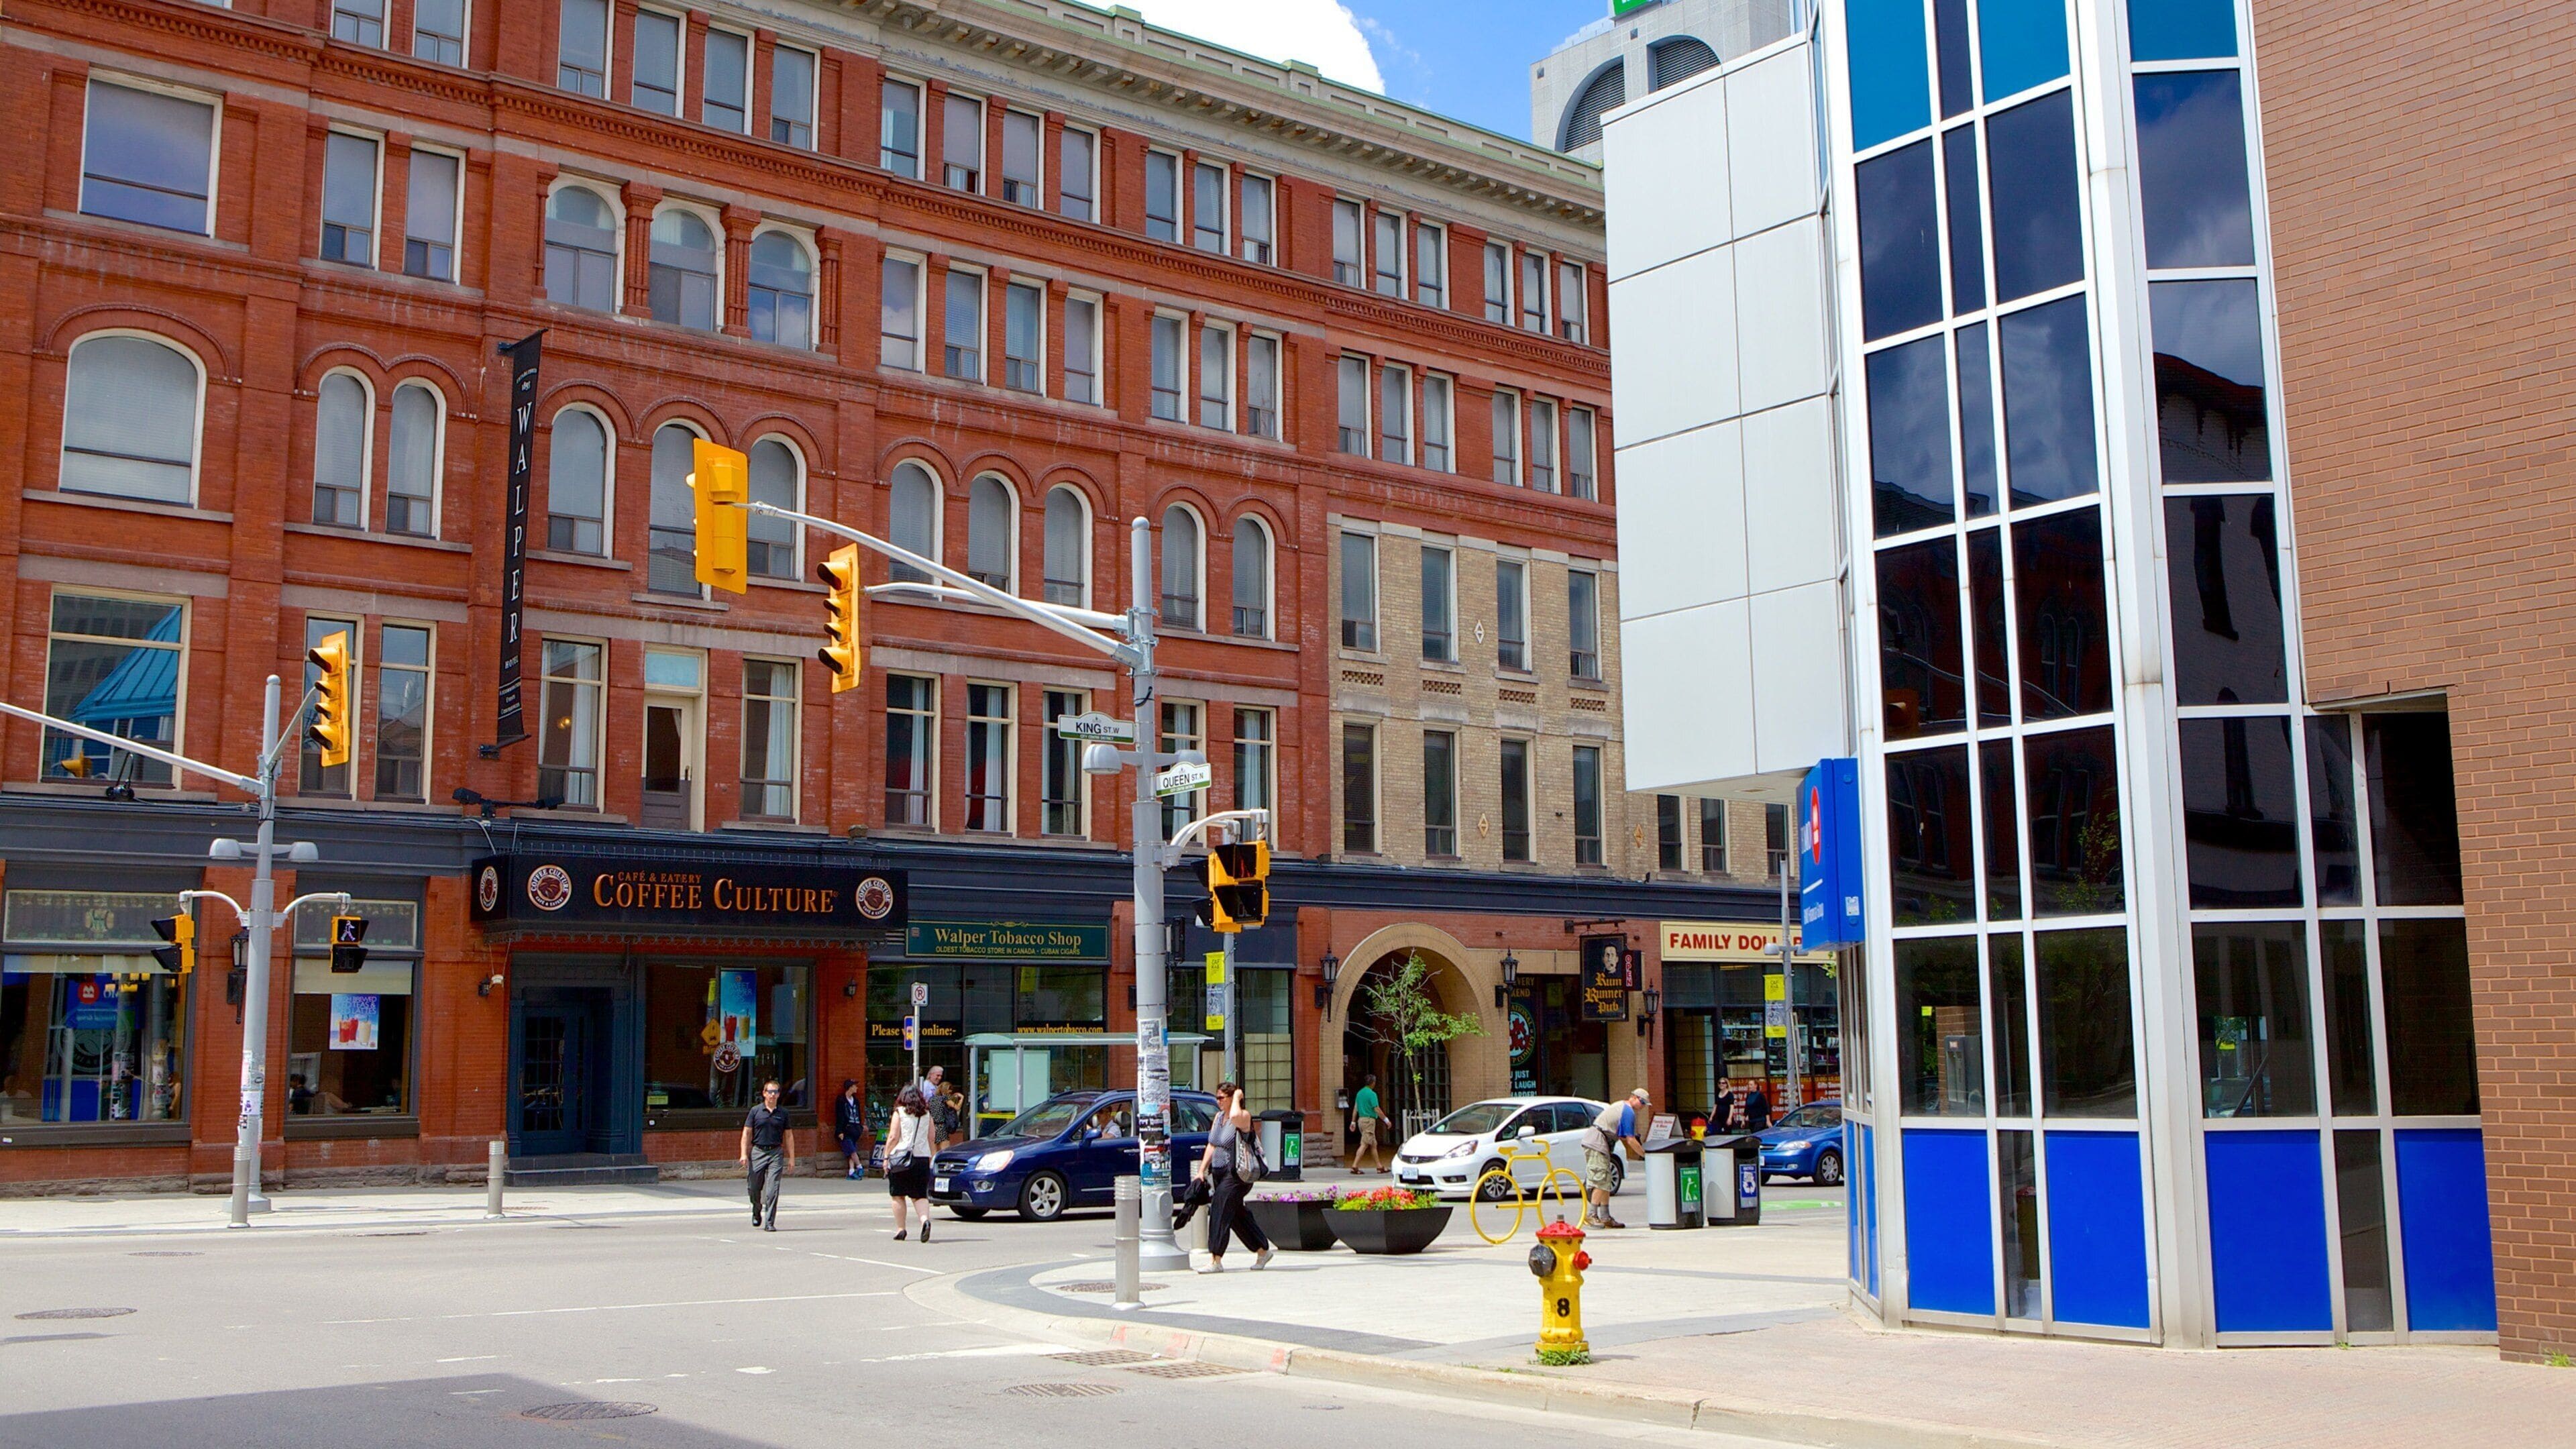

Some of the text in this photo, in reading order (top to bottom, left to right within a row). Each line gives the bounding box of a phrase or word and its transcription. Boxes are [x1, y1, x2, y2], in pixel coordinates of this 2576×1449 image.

[509, 402, 532, 643] WALPER
[1075, 722, 1101, 734] KING
[1163, 773, 1189, 788] QUEEN
[531, 869, 569, 893] COFFEE CULTURE
[619, 870, 702, 884] CAFÉ & EATERY
[594, 873, 702, 910] COFFEE
[859, 880, 891, 902] COFFEE CULTURE
[934, 928, 1081, 948] Walper Tobacco Shop
[1670, 933, 1731, 949] FAMILY
[1625, 955, 1633, 987] OPEN
[1595, 972, 1622, 986] Rum
[1585, 987, 1623, 1002] Runner
[1598, 1000, 1619, 1014] Pub
[872, 1024, 900, 1036] Please
[1515, 1070, 1529, 1080] JUST
[1515, 1080, 1536, 1089] LAUGH
[1557, 1297, 1570, 1318] 8
